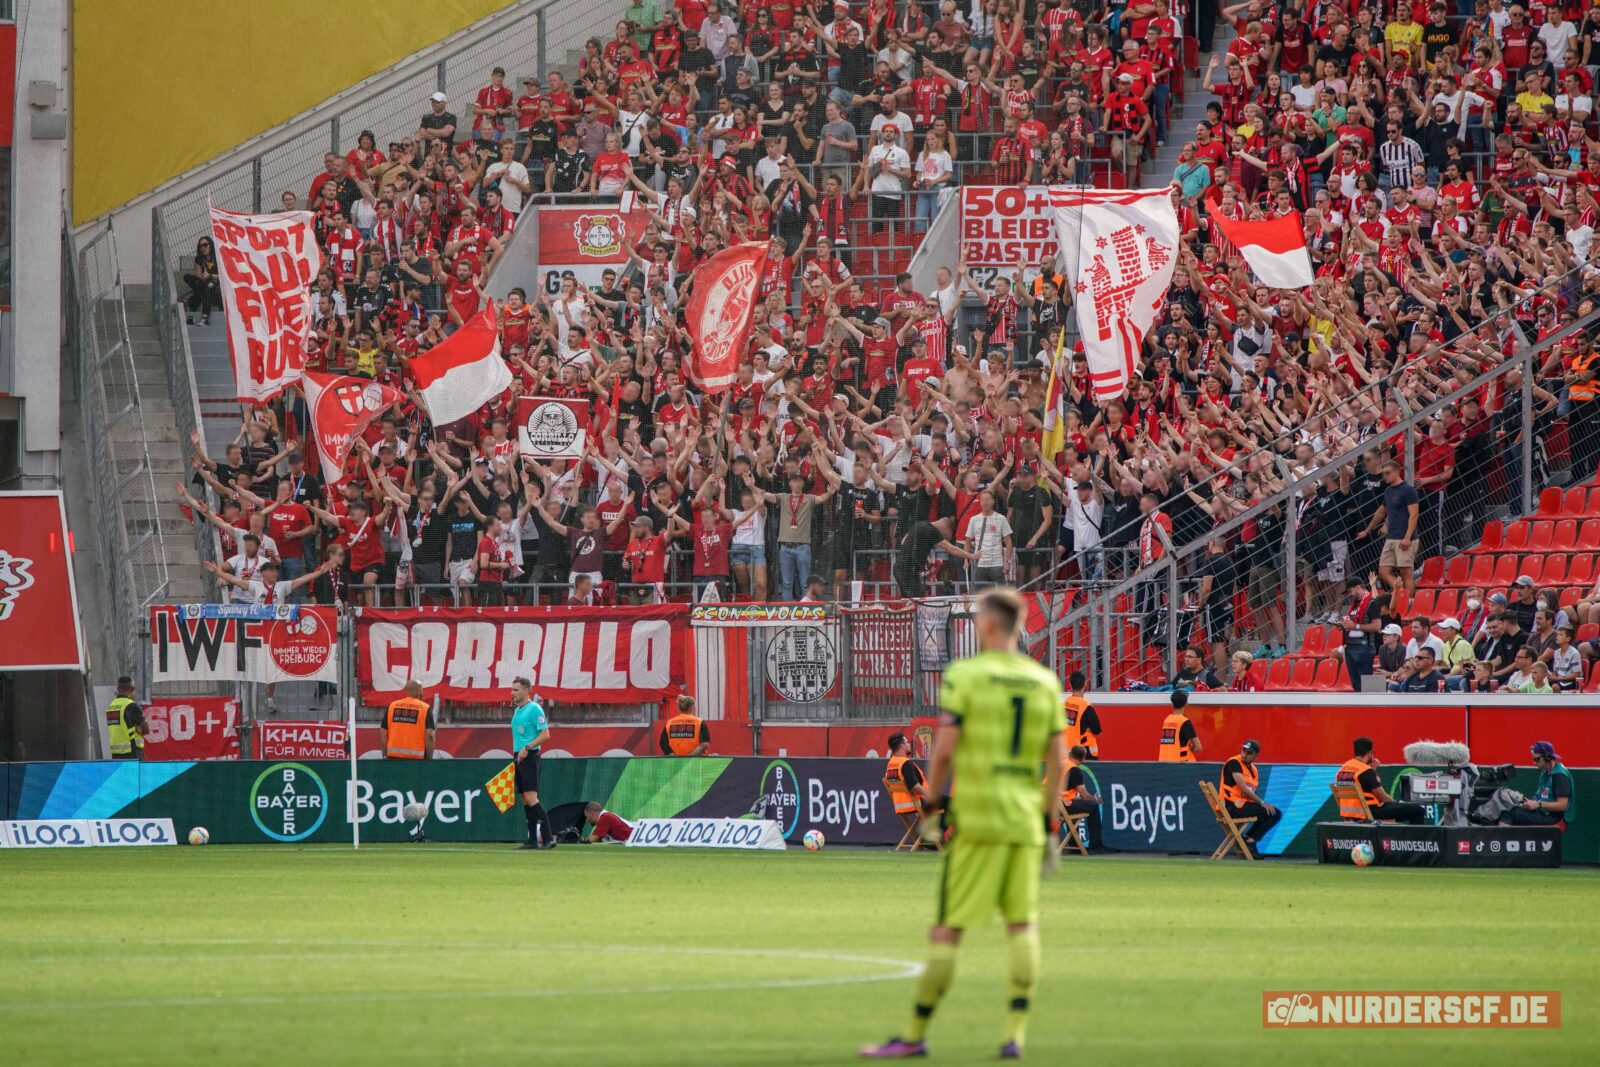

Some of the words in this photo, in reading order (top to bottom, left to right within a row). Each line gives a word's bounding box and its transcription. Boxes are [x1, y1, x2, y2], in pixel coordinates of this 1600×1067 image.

[1428, 34, 1449, 43] HUGO
[966, 242, 1058, 262] BASTA
[234, 286, 308, 335] FRE
[247, 331, 308, 385] BUR
[217, 603, 248, 616] Sydney
[764, 606, 823, 620] VOLTS
[157, 612, 262, 672] IWF
[302, 646, 327, 655] WIEDER
[279, 653, 322, 665] FREIBURG
[369, 620, 671, 692] CORRILLO
[143, 702, 238, 743] 50+1
[1010, 697, 1025, 758] 1
[266, 728, 344, 745] KHALID
[265, 743, 295, 756] FÜR
[299, 746, 346, 758] IMMER
[257, 796, 321, 808] BAYER
[346, 779, 482, 836] Bayer
[767, 793, 797, 806] AYER
[808, 778, 880, 836] Bayer
[1111, 783, 1188, 844] Bayer
[12, 822, 85, 845] iLOQ
[96, 821, 169, 843] iLOQ
[631, 820, 673, 844] iLOQ
[675, 819, 716, 844] iLOQ
[717, 821, 762, 845] iLOQ
[1390, 840, 1440, 852] BUNDESLIGA
